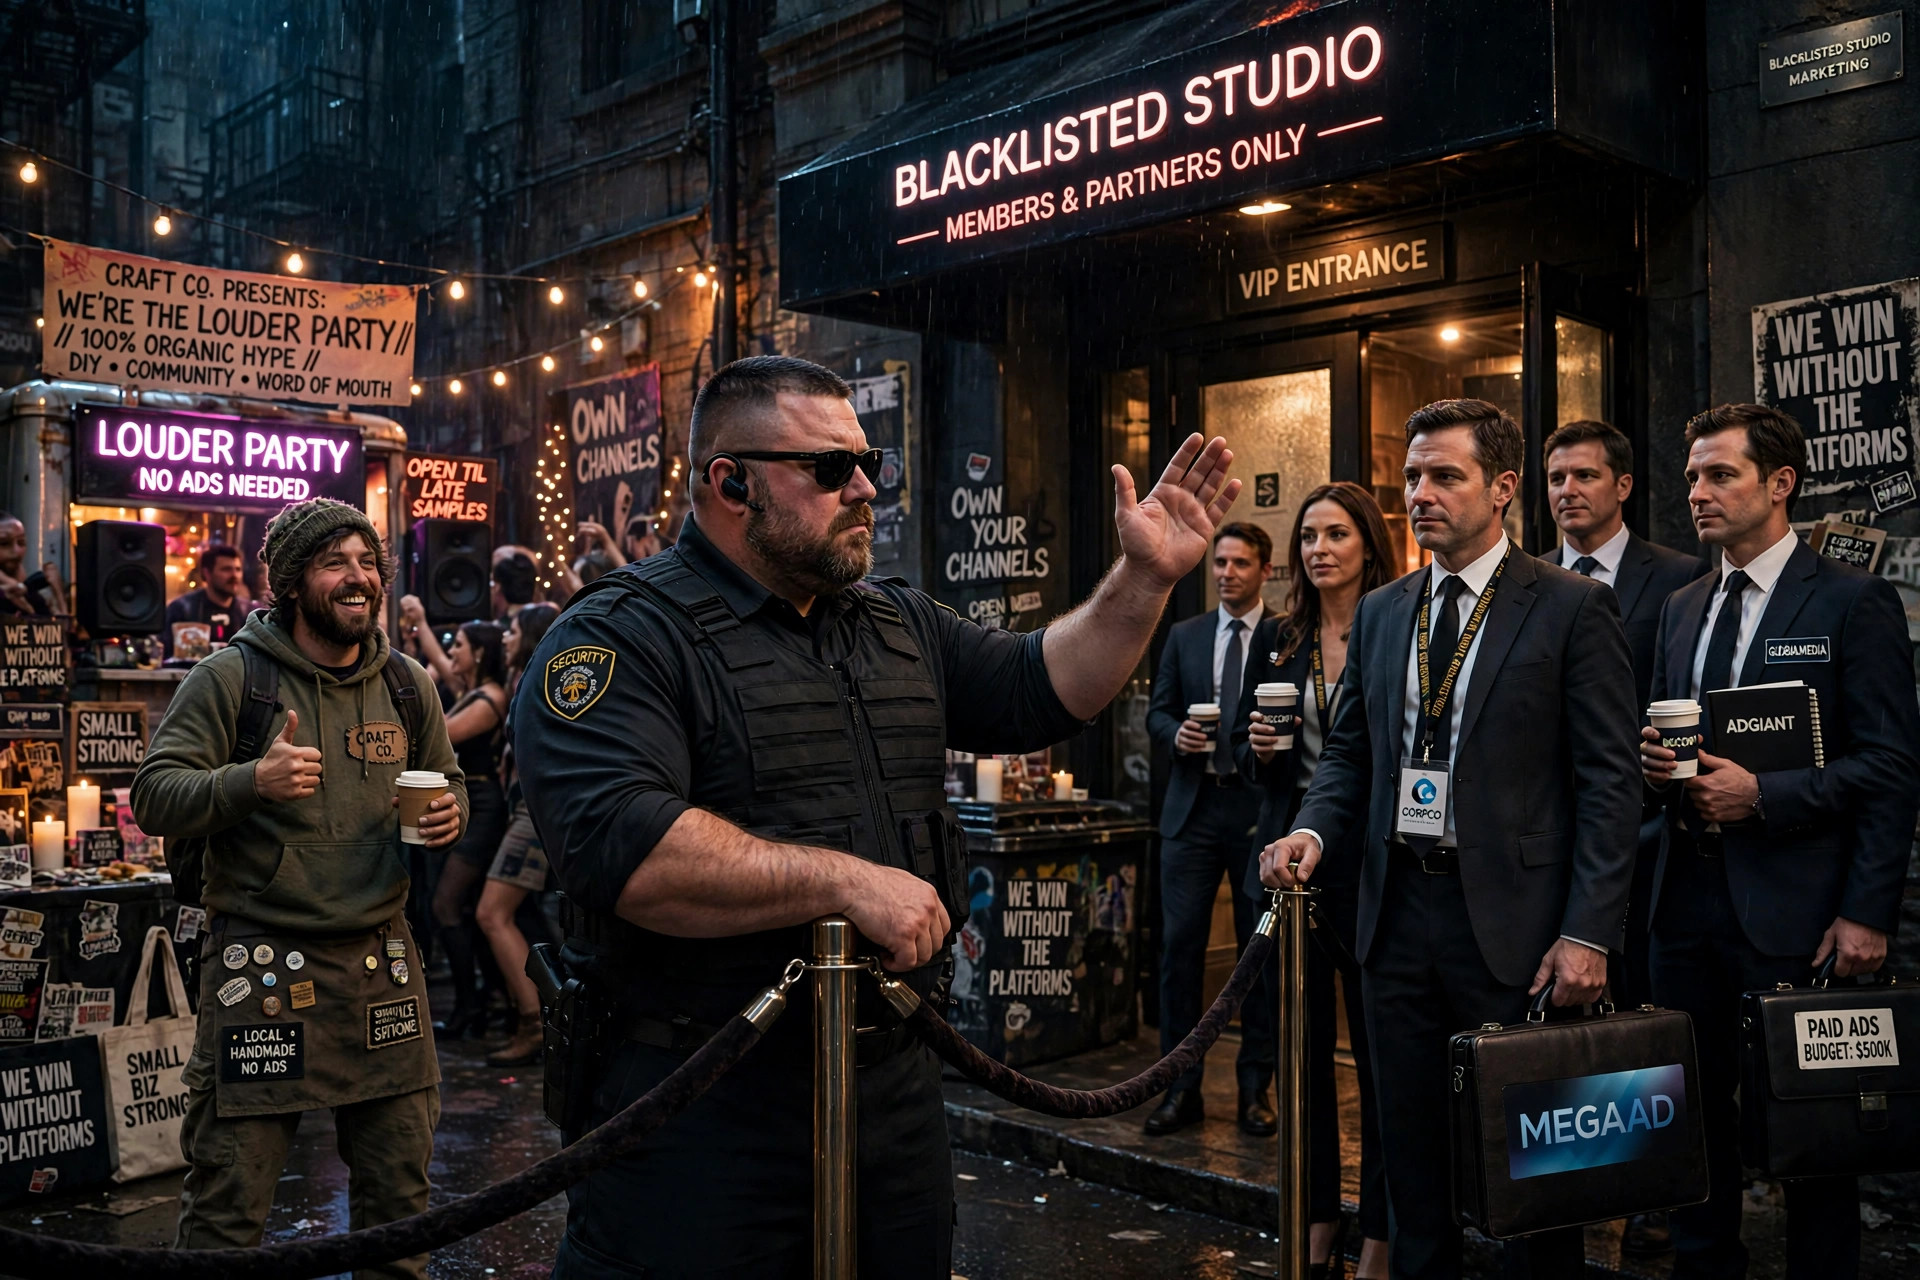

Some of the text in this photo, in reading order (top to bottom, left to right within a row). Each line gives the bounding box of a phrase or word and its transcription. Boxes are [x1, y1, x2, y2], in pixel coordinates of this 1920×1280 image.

[1846, 32, 1891, 53] STUDIO
[1789, 57, 1870, 87] MARKETING
[895, 26, 1382, 207] BLACKLISTED STUDIO
[946, 123, 1306, 243] MEMBERS & PARTNERS ONLY
[1239, 239, 1428, 299] VIP ENTRANCE
[105, 262, 177, 294] CRAFT
[223, 279, 326, 309] PRESENTS:
[58, 289, 134, 325] WE'RE
[143, 301, 188, 330] THE
[198, 304, 301, 344] LOUDER
[1774, 297, 1895, 357] WE WIN
[81, 327, 136, 353] 100%
[144, 334, 234, 364] ORGANIC
[242, 344, 296, 369] HYPE
[69, 352, 392, 399] DIY COMMUNITY WORD OF MOUTH
[1773, 342, 1901, 399] WITHOUT
[572, 391, 626, 445] OWN
[1813, 391, 1863, 433] THE
[98, 419, 350, 474] LOUDER PARTY
[577, 434, 660, 484] CHANNELS
[1805, 427, 1908, 473] ATFORMS
[139, 467, 310, 501] NO ADS NEEDED
[407, 458, 488, 483] OPEN TIL
[420, 479, 467, 501] LATE
[951, 486, 1002, 519] OWN
[412, 499, 488, 522] SAMPLES
[971, 516, 1027, 550] YOUR
[945, 547, 1049, 582] CHANNELS
[4, 624, 62, 645] WE WIN
[4, 646, 63, 666] WITHOUT
[551, 650, 608, 673] SECURITY
[80, 712, 137, 737] SMALL
[1726, 715, 1795, 733] ADGIANT
[78, 739, 144, 764] STRONG
[376, 744, 395, 757] CO.
[1402, 807, 1441, 820] CORPCO
[1008, 880, 1068, 908] WE WIN
[1003, 911, 1073, 937] WITHOUT
[1022, 940, 1050, 966] THE
[989, 969, 1073, 996] PLATFORMS
[244, 1029, 283, 1043] LOCAL
[1807, 1015, 1880, 1039] PAID ADS
[127, 1045, 184, 1075] SMALL
[230, 1044, 296, 1060] HANDMADE
[1803, 1040, 1893, 1062] BUDGET: $500K
[1, 1060, 73, 1098] WE WIN
[241, 1060, 287, 1075] NO ADS
[131, 1074, 160, 1101] BIZ
[0, 1089, 82, 1130] WITHOUT
[124, 1092, 189, 1128] STRONG
[1519, 1094, 1675, 1149] MEGAAD
[0, 1119, 95, 1164] PLATFORMS
